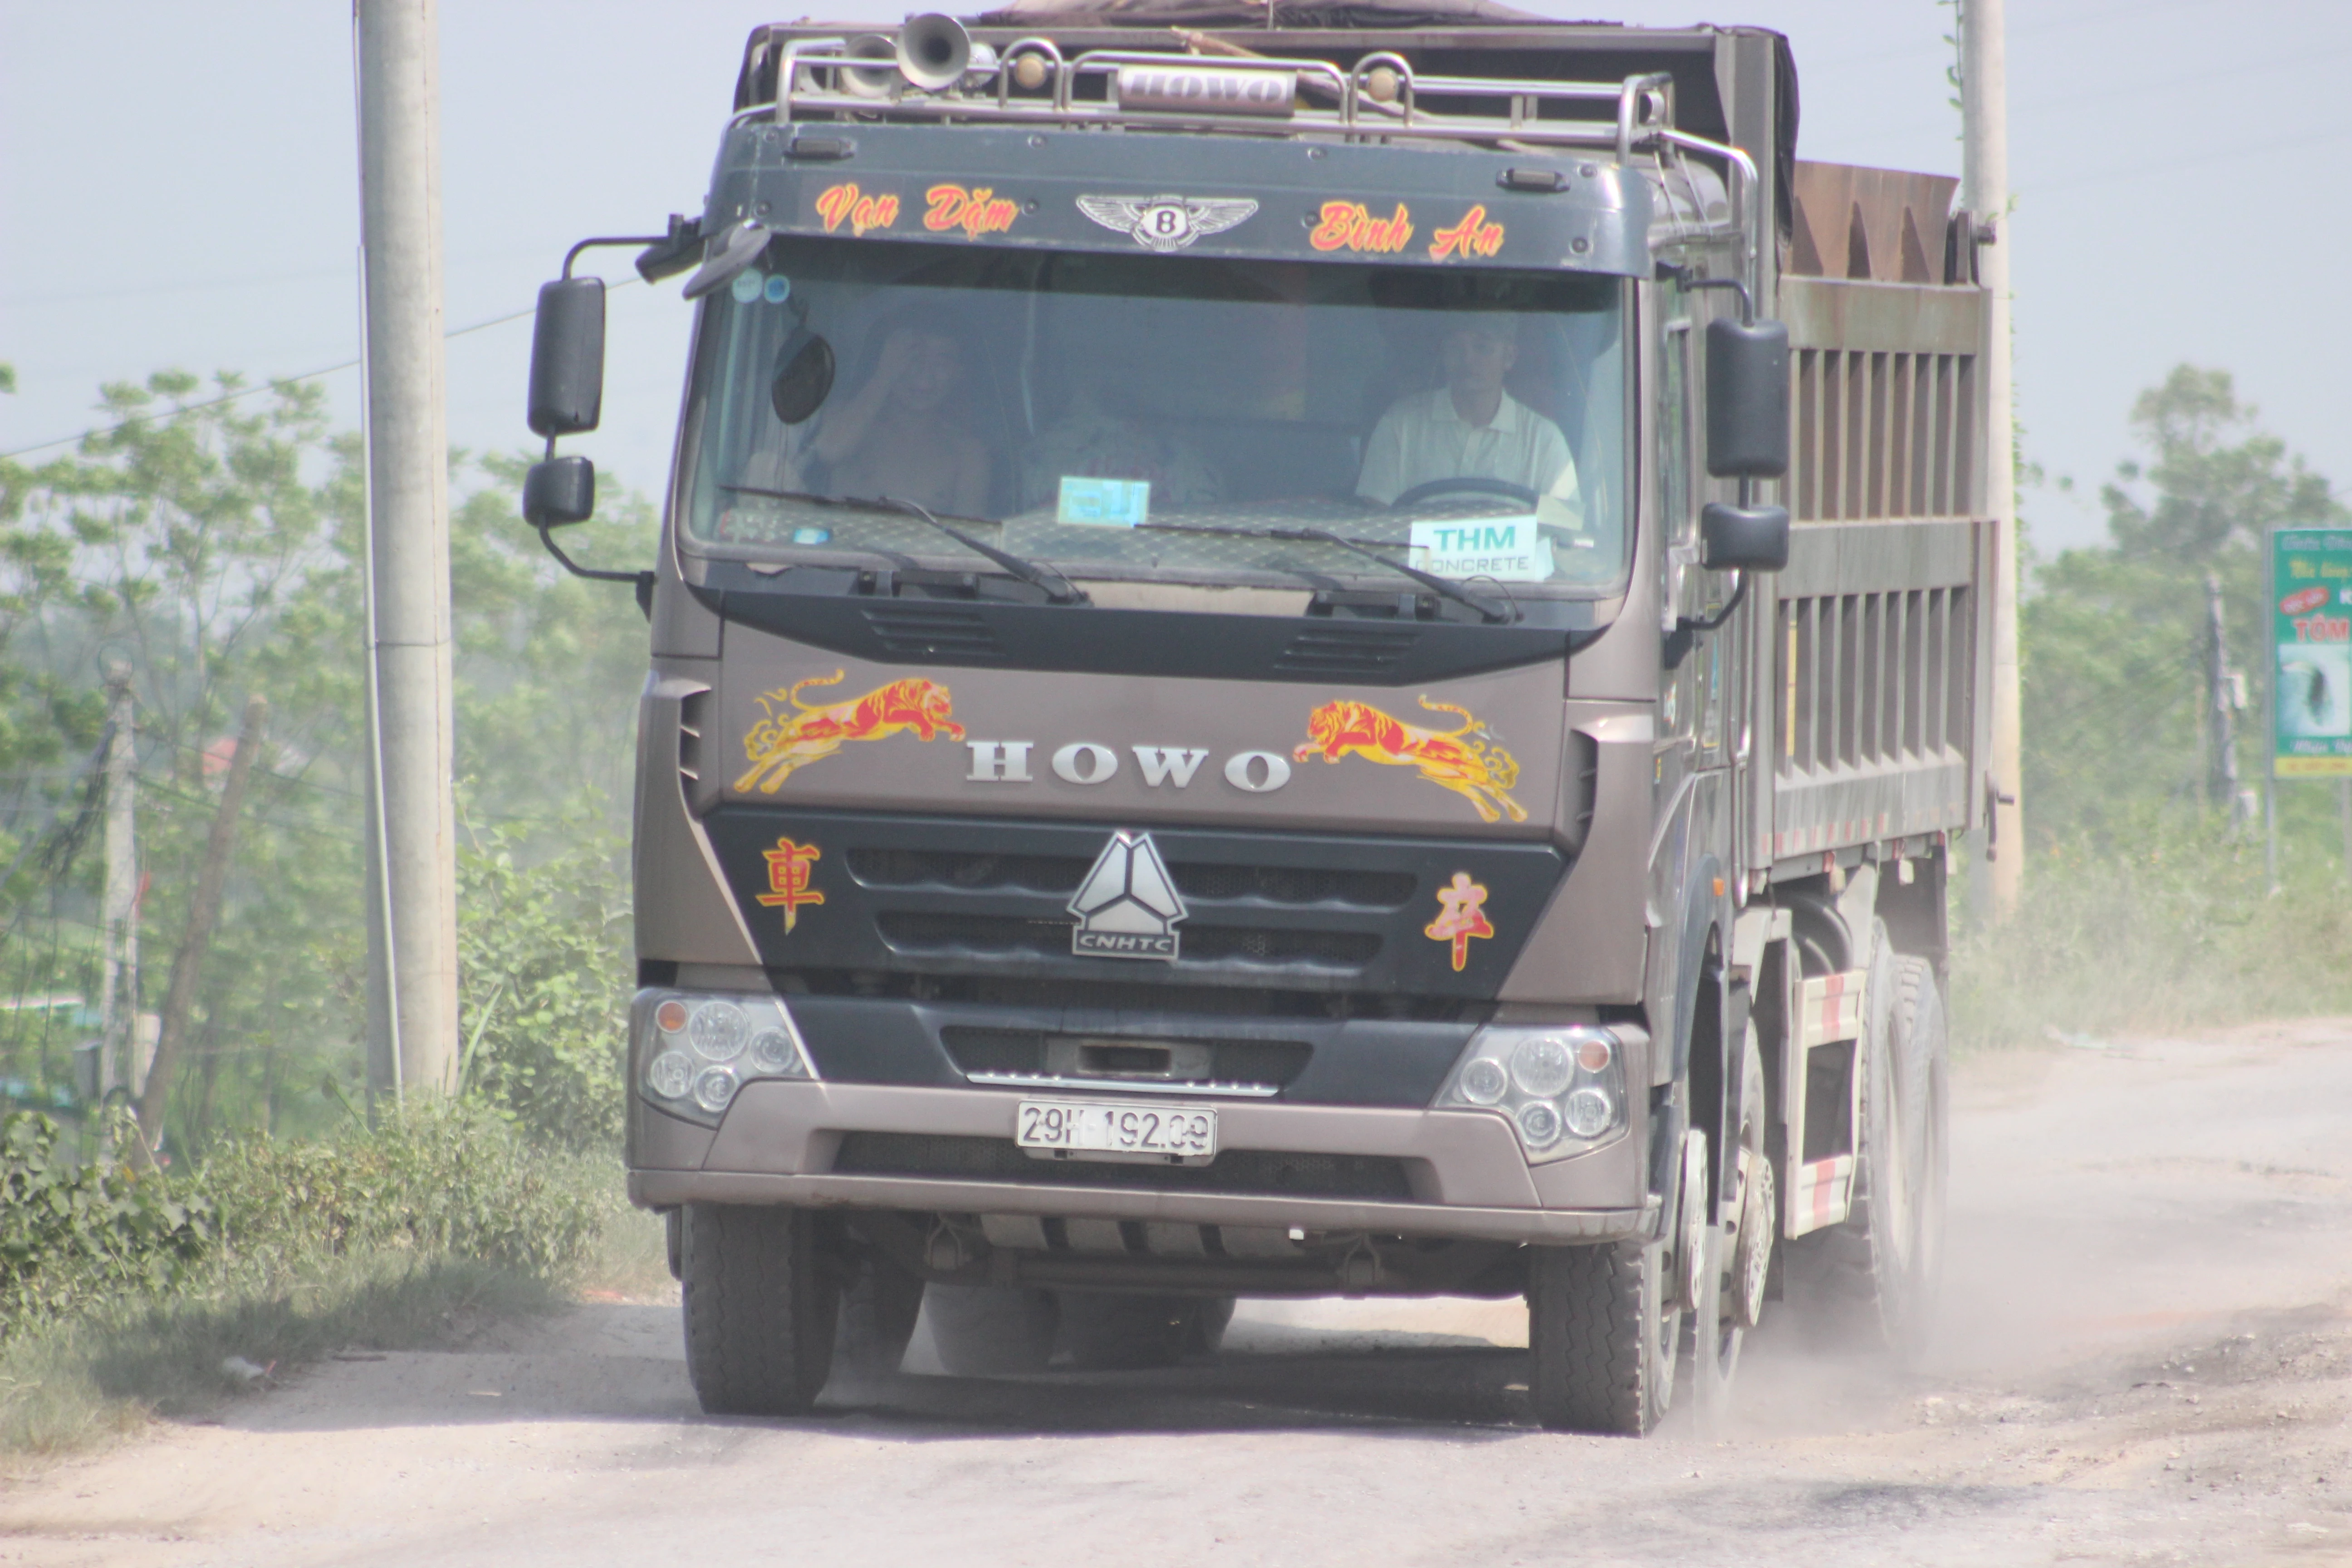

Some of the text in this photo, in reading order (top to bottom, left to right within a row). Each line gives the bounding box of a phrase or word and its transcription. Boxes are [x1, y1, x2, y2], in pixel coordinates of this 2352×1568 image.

[1429, 204, 1504, 262] An
[1433, 526, 1516, 552] THM
[966, 740, 1291, 793] HOWO
[1079, 935, 1171, 951] CNHTC
